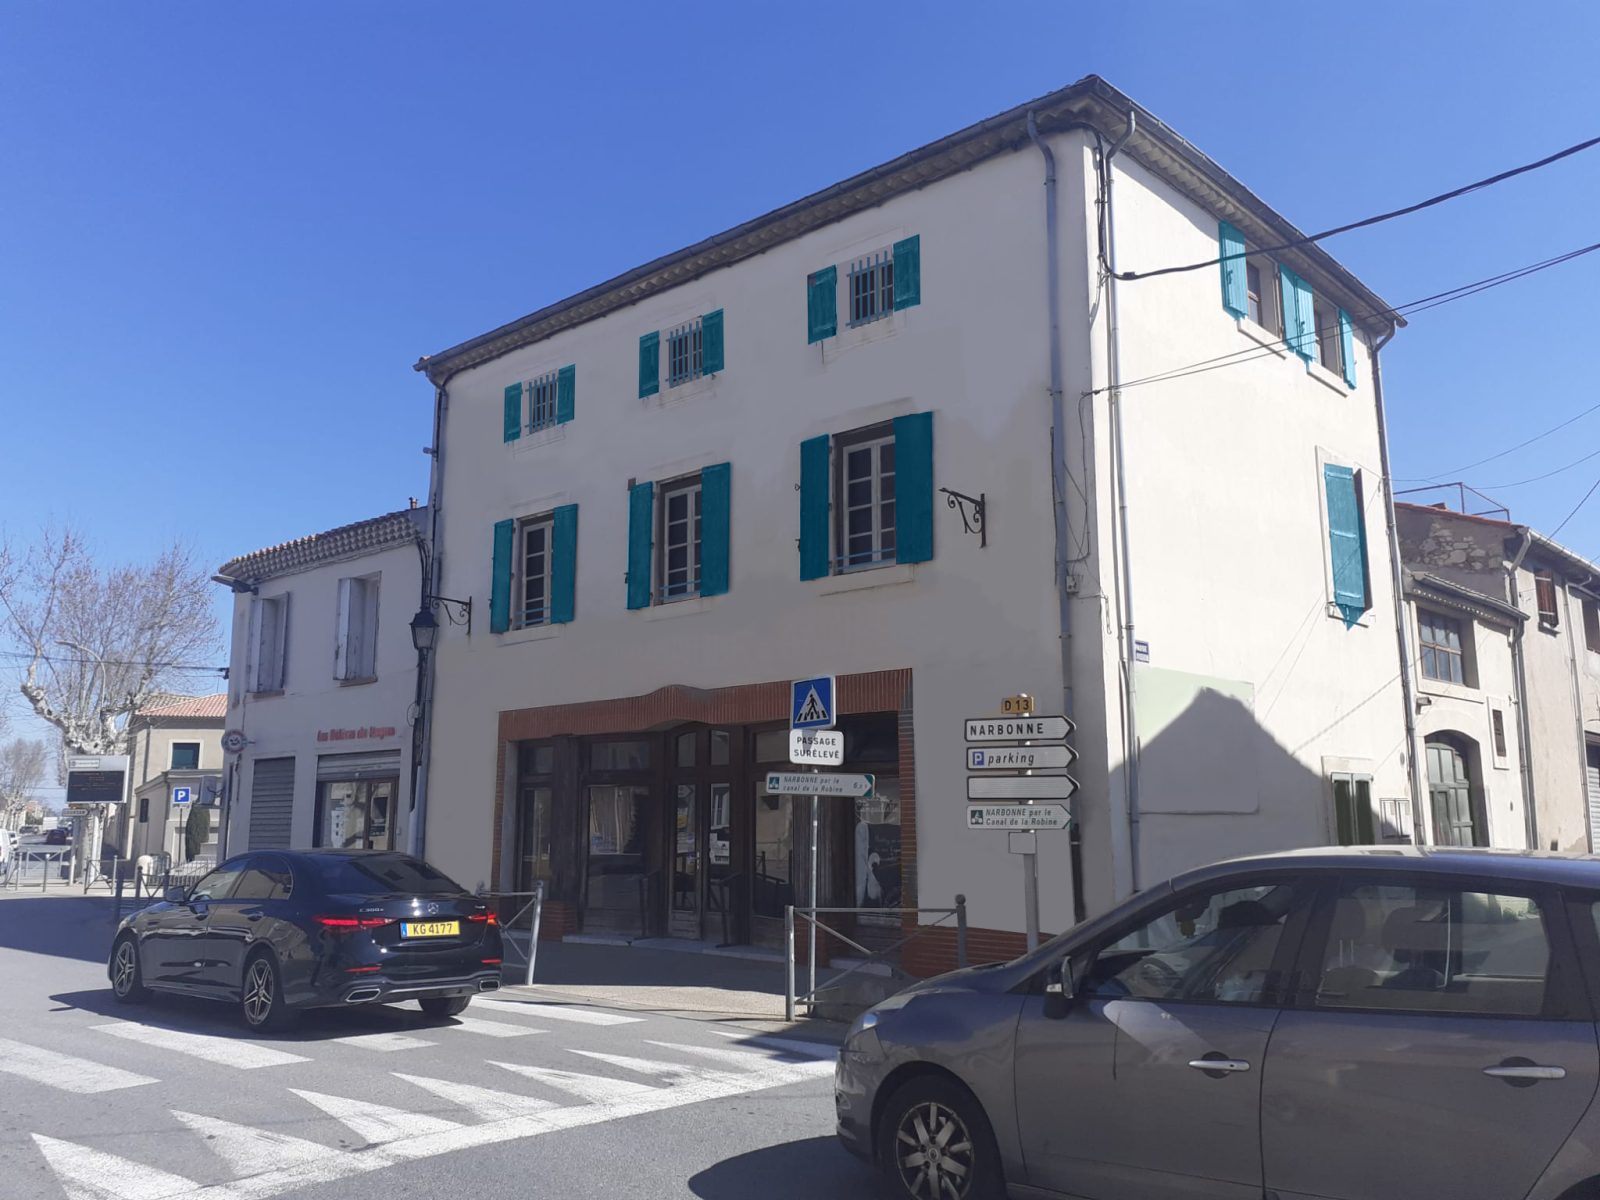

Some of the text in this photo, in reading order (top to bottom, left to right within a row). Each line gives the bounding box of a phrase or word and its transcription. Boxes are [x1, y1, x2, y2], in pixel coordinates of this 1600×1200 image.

[1004, 699, 1030, 711] D 13
[970, 723, 1044, 736] NARBONNE
[797, 737, 836, 746] PASSAGE
[793, 748, 840, 759] SURÉLEVÉ
[974, 752, 1035, 767] P parking
[783, 775, 818, 784] NARBONNE
[985, 807, 1052, 818] NARBONNE par le
[985, 817, 1058, 826] Canal de la Robine
[413, 924, 426, 935] KG
[428, 923, 453, 934] 4177
